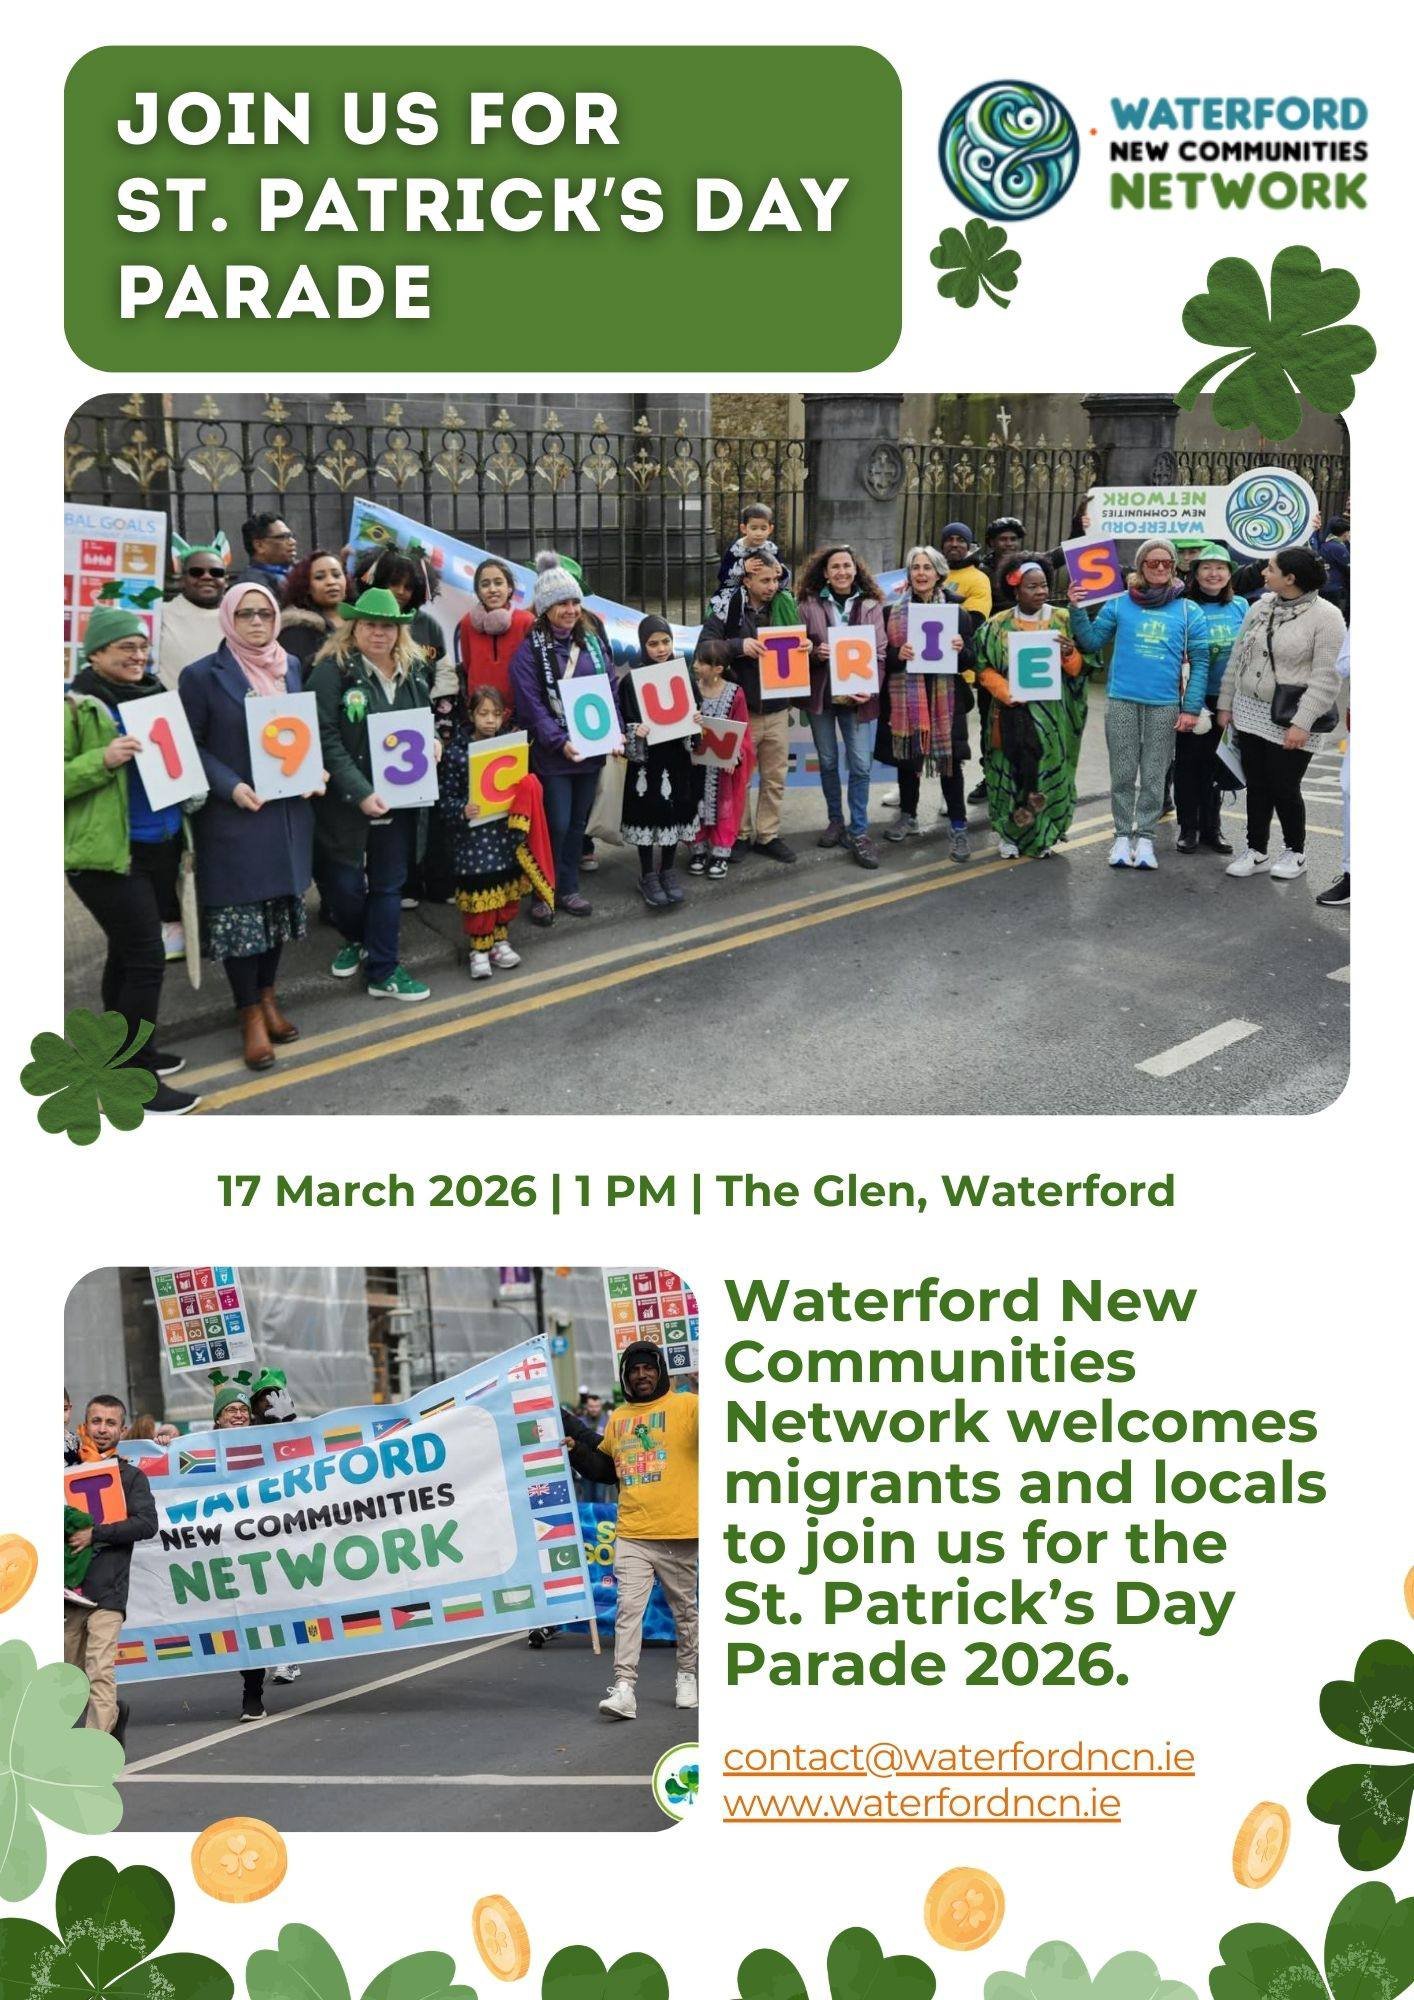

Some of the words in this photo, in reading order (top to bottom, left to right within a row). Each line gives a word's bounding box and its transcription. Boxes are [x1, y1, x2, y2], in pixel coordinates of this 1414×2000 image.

[117, 91, 310, 147] JOIN
[344, 91, 440, 147] US
[470, 91, 621, 147] FOR
[1109, 96, 1369, 131] WATERFORD
[1110, 141, 1170, 162] NEW
[1178, 140, 1369, 162] COMMUNITIES
[117, 177, 229, 233] ST.
[260, 177, 665, 233] PATRICK'S
[696, 177, 850, 232] DAY
[1109, 171, 1369, 210] NETWORK
[119, 264, 431, 320] PARADE
[1102, 509, 1178, 518] COMMUNITIES
[1103, 491, 1206, 506] NETWORK
[1182, 509, 1206, 518] NEW
[100, 515, 156, 533] GOALS
[1077, 547, 1116, 591] S
[763, 635, 801, 679] T
[835, 639, 873, 681] R
[921, 621, 944, 662] I
[1017, 646, 1054, 689] E
[641, 675, 691, 726] U
[150, 716, 184, 779] 1
[261, 716, 312, 777] 9
[382, 728, 429, 786] 3
[696, 727, 739, 761] N
[480, 755, 520, 804] C
[217, 1175, 261, 1207] 17
[277, 1173, 415, 1207] March
[428, 1174, 537, 1208] 2026
[575, 1175, 590, 1207] 1
[607, 1175, 675, 1207] PM
[715, 1173, 800, 1207] The
[813, 1173, 927, 1214] Glen,
[941, 1172, 1175, 1207] Waterford
[724, 1276, 1039, 1323] Waterford
[1062, 1279, 1198, 1322] New
[724, 1335, 1136, 1384] Communities
[727, 1398, 990, 1444] Network
[1006, 1398, 1318, 1444] welcomes
[69, 1473, 114, 1525] T
[726, 1456, 1001, 1516] migrants
[1019, 1459, 1132, 1505] and
[1155, 1459, 1327, 1505] locals
[159, 1523, 223, 1552] NEW
[234, 1483, 455, 1541] COMMUNITIES
[168, 1519, 464, 1605] NETWORK
[723, 1524, 786, 1565] to
[797, 1516, 915, 1576] join
[938, 1530, 1005, 1565] us
[1022, 1518, 1108, 1564] for
[1125, 1519, 1227, 1565] the
[724, 1580, 802, 1626] St.
[825, 1577, 1095, 1626] Patrick’s
[1116, 1581, 1236, 1637] Day
[727, 1640, 946, 1687] Parade
[964, 1641, 1129, 1687] 2026.
[723, 1741, 1195, 1777] contact@waterfordncn.ie
[723, 1787, 1121, 1823] www.waterfordncn.ie
